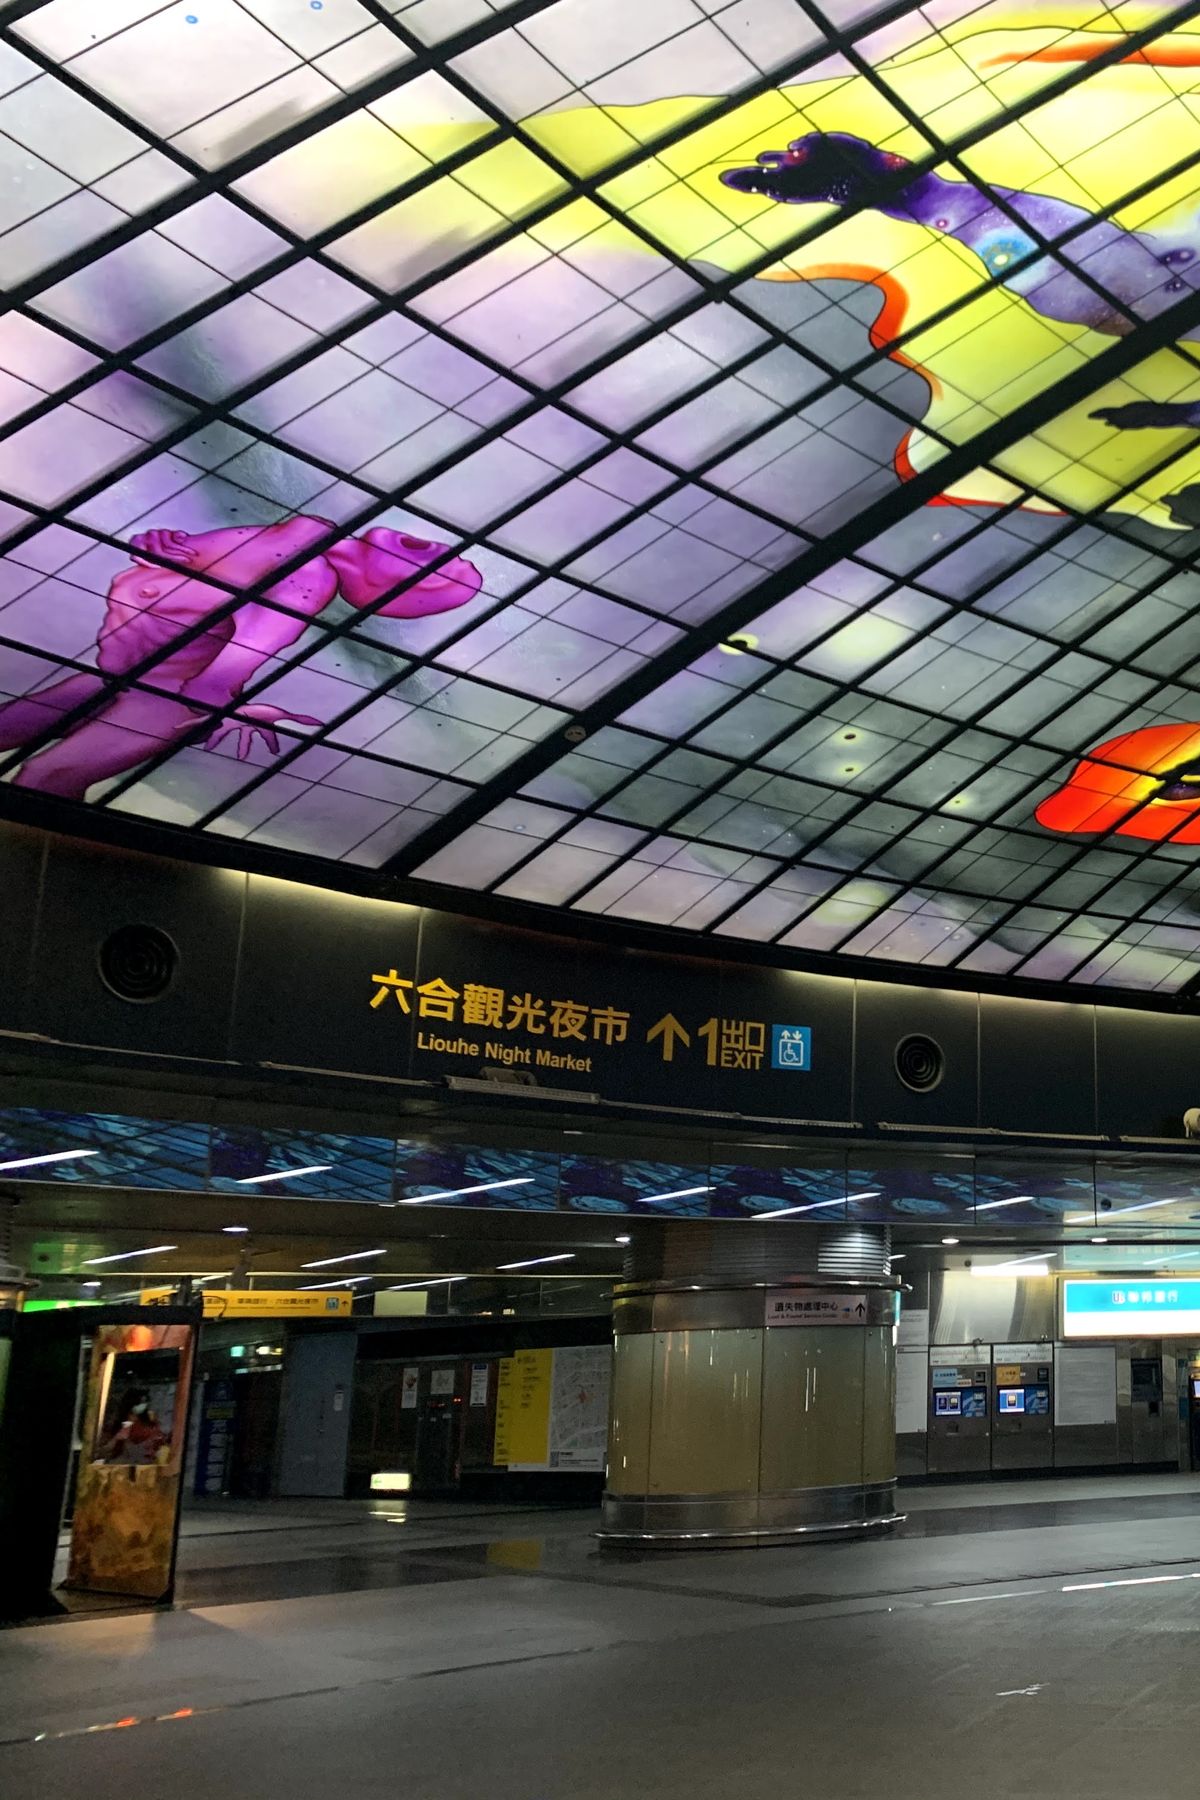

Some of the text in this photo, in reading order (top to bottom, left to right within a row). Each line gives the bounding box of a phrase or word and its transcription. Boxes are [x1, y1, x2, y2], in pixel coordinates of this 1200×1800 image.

[370, 969, 630, 1046] 六合觀光夜市
[417, 1032, 592, 1073] Liouhe Night Market
[721, 1018, 765, 1052] 出口
[721, 1050, 764, 1070] EXIT
